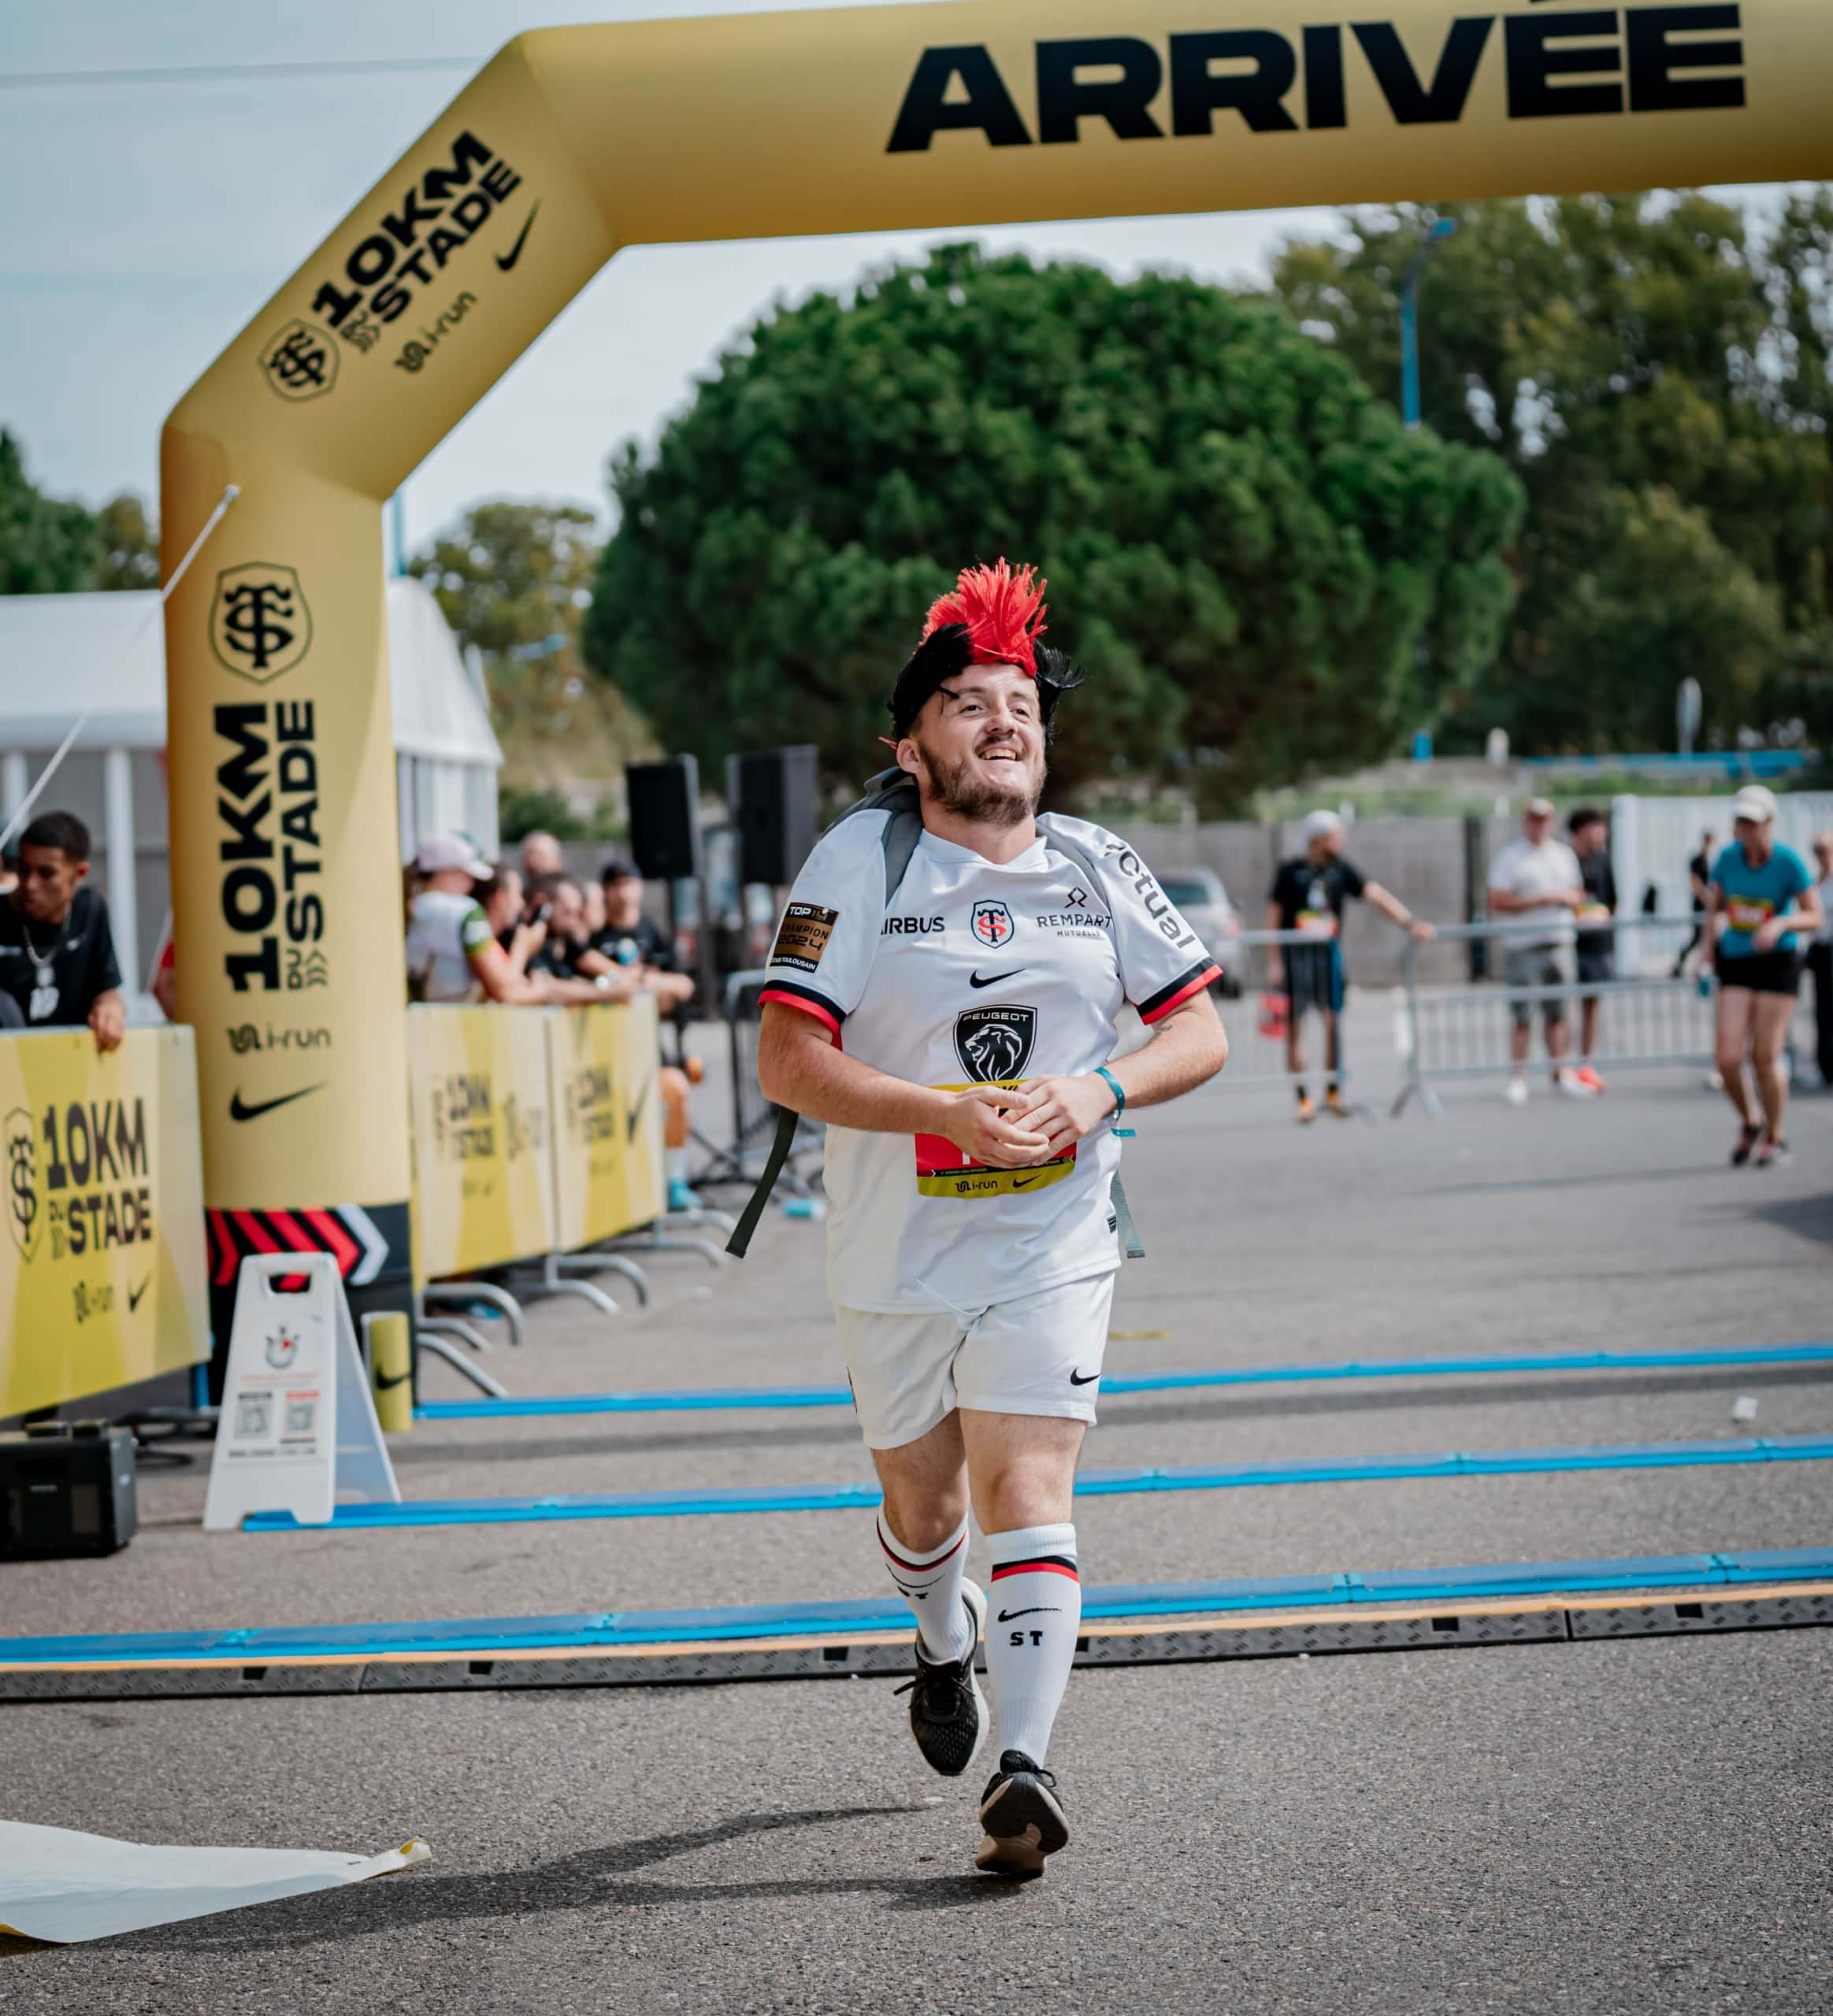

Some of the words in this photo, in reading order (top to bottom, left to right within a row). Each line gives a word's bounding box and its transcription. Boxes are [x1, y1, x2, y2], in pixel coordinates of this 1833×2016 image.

[885, 0, 1747, 153] ARRIVÉE
[310, 128, 495, 328] 10KM
[369, 159, 523, 324] STADE
[213, 702, 280, 992] 10KM
[275, 700, 325, 943] STADE
[789, 906, 812, 916] TOP
[881, 916, 945, 936] IRBUS
[1036, 914, 1111, 928] REMPART
[963, 1012, 1030, 1021] PEUGEOT
[42, 1097, 149, 1191] 10KM
[67, 1187, 152, 1255] STADE
[1009, 1630, 1044, 1647] ST
